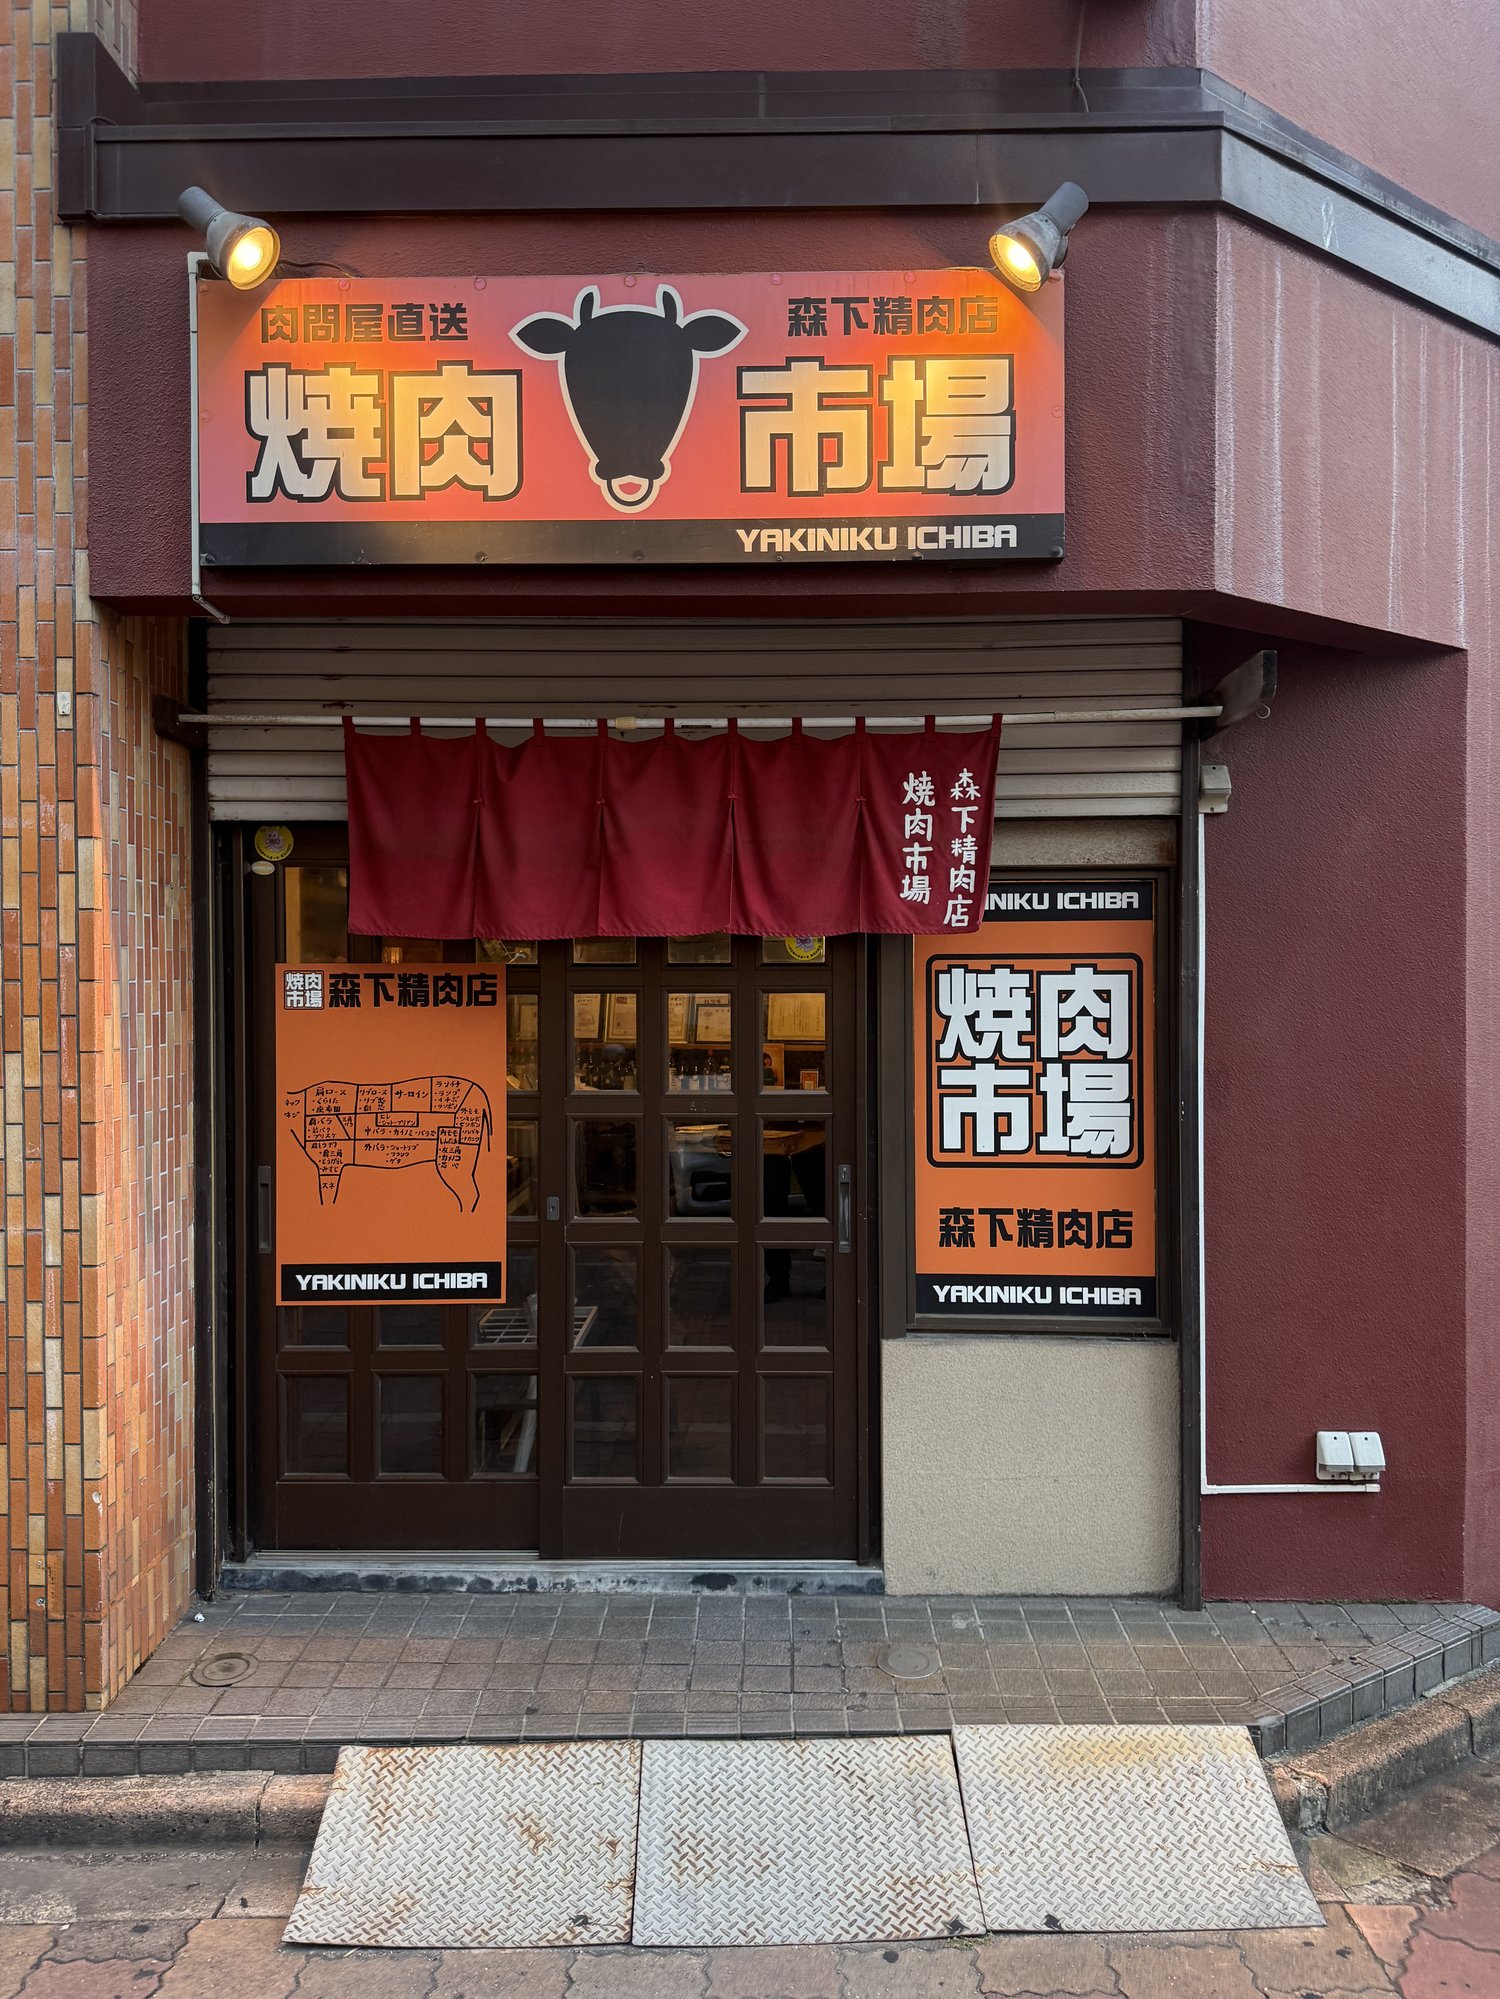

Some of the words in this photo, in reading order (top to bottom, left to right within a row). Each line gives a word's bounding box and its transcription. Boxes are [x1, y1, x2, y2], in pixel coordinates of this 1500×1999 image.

[260, 303, 469, 344] 肉問屋直送
[788, 296, 998, 336] 森下精肉店
[245, 360, 523, 503] 焼肉
[737, 354, 1016, 497] 市場
[736, 527, 896, 552] YAKINIKU
[908, 524, 1017, 549] ICHIBA
[943, 768, 981, 927] 森下精肉店
[1057, 891, 1138, 909] ICHIBA
[286, 973, 322, 989] 焼肉
[329, 973, 498, 1007] 森下精肉店
[287, 990, 322, 1007] 市場
[936, 964, 1133, 1061] 焼肉
[395, 1089, 429, 1099] サーロイン
[938, 1059, 1134, 1158] 市場
[938, 1207, 1133, 1249] 森下精肉店
[296, 1273, 406, 1290] YAKINIKU
[413, 1272, 488, 1289] ICHIBA
[933, 1285, 1051, 1304] YAKINIKU
[1060, 1286, 1141, 1305] ICHIBA
